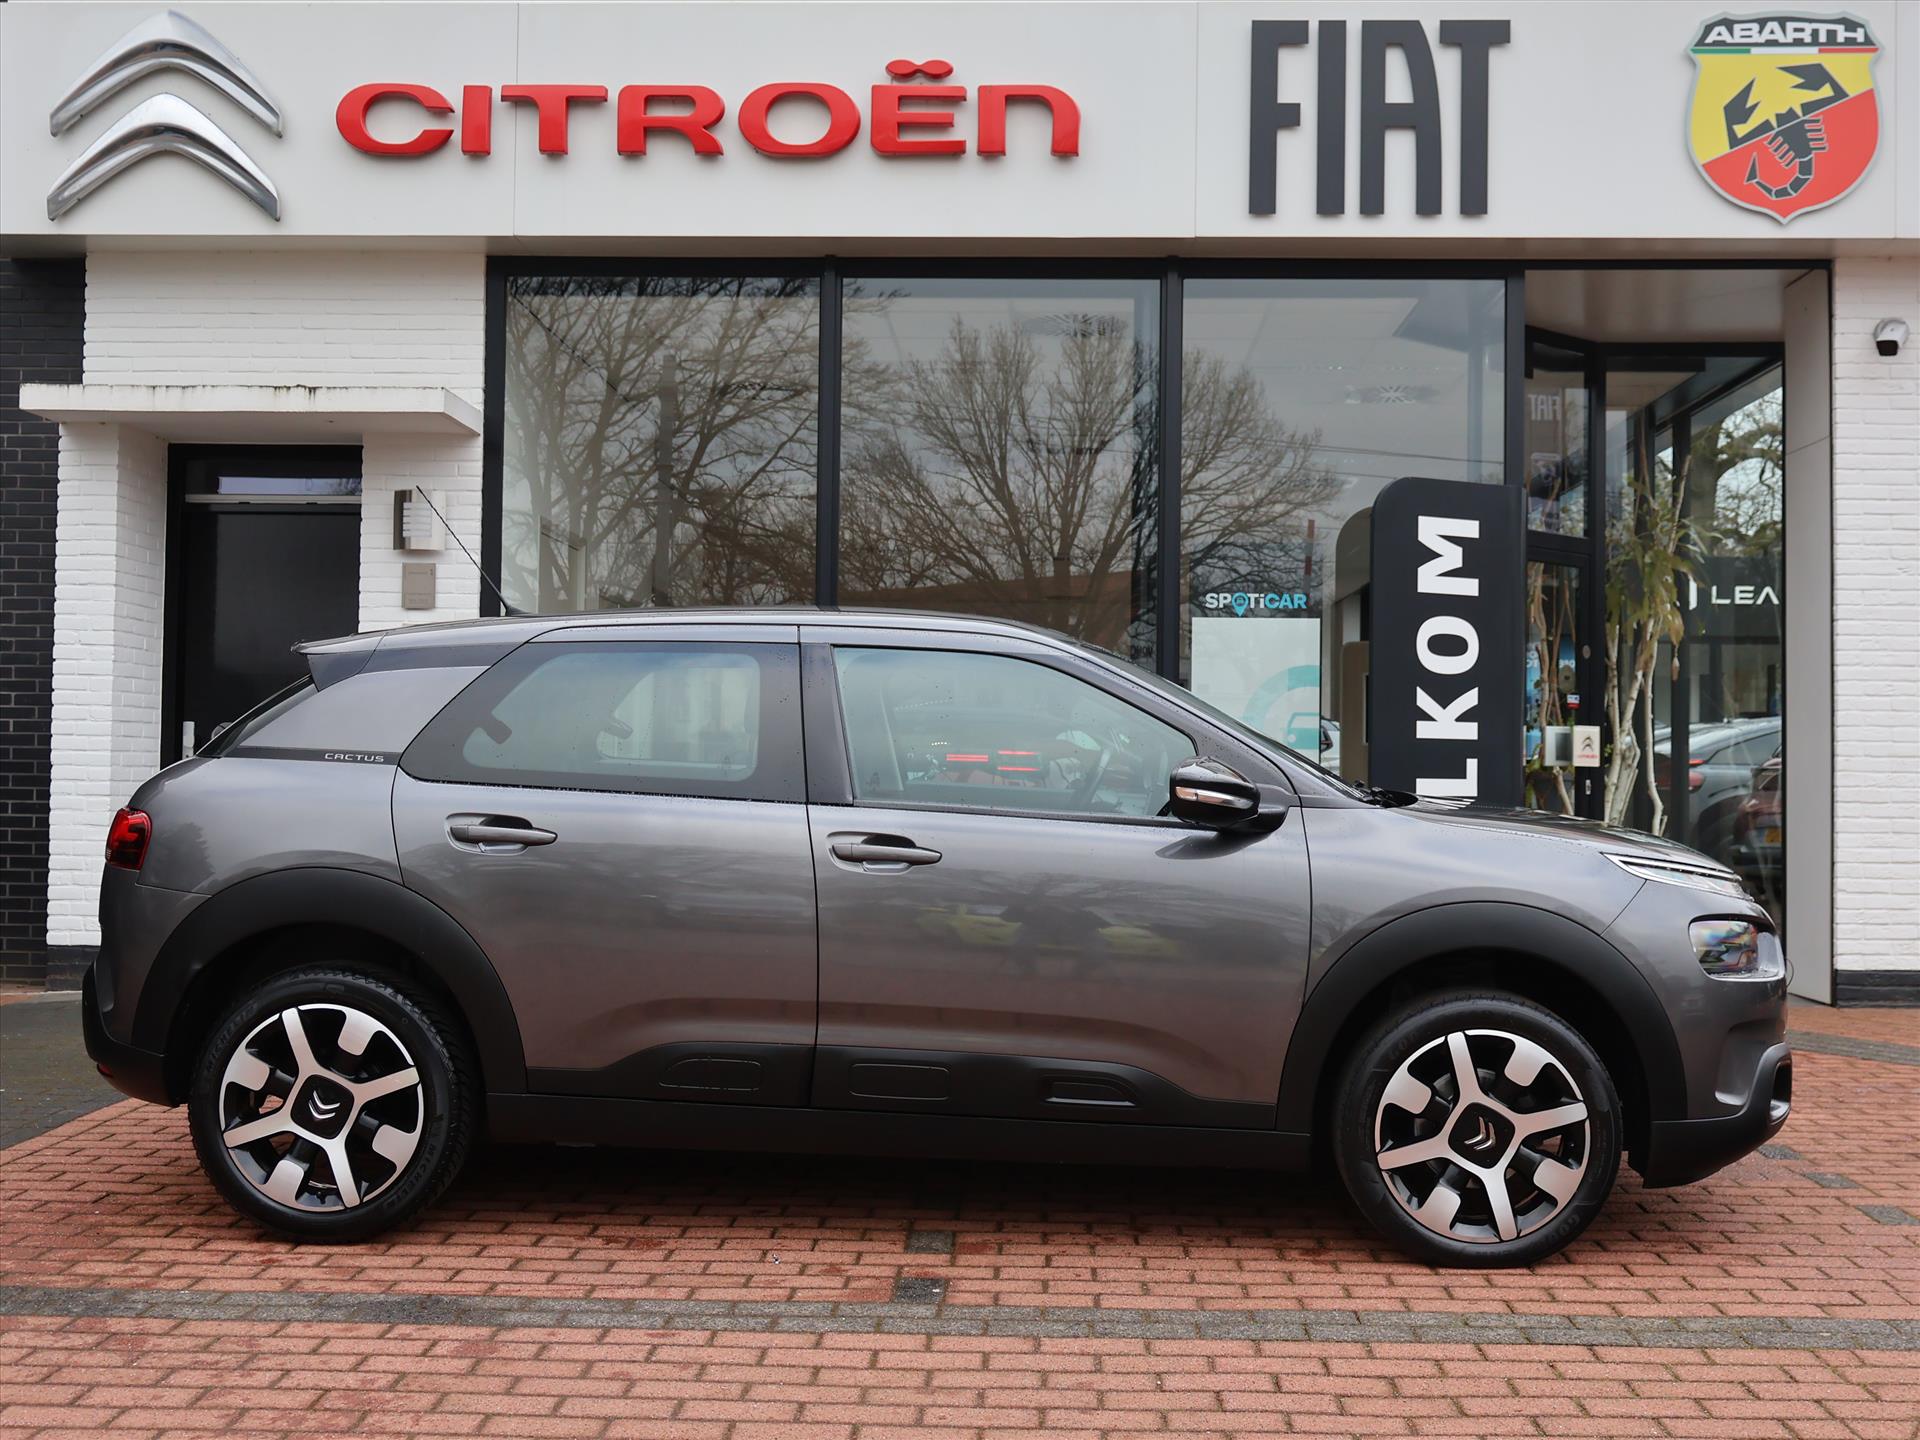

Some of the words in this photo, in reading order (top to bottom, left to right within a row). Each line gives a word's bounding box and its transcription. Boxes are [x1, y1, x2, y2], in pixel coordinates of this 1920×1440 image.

[1703, 21, 1866, 44] ABARTH
[335, 59, 1082, 158] CITROËN
[1249, 19, 1511, 219] FIAT
[1415, 515, 1481, 798] LKOM
[324, 752, 385, 763] CACTUS
